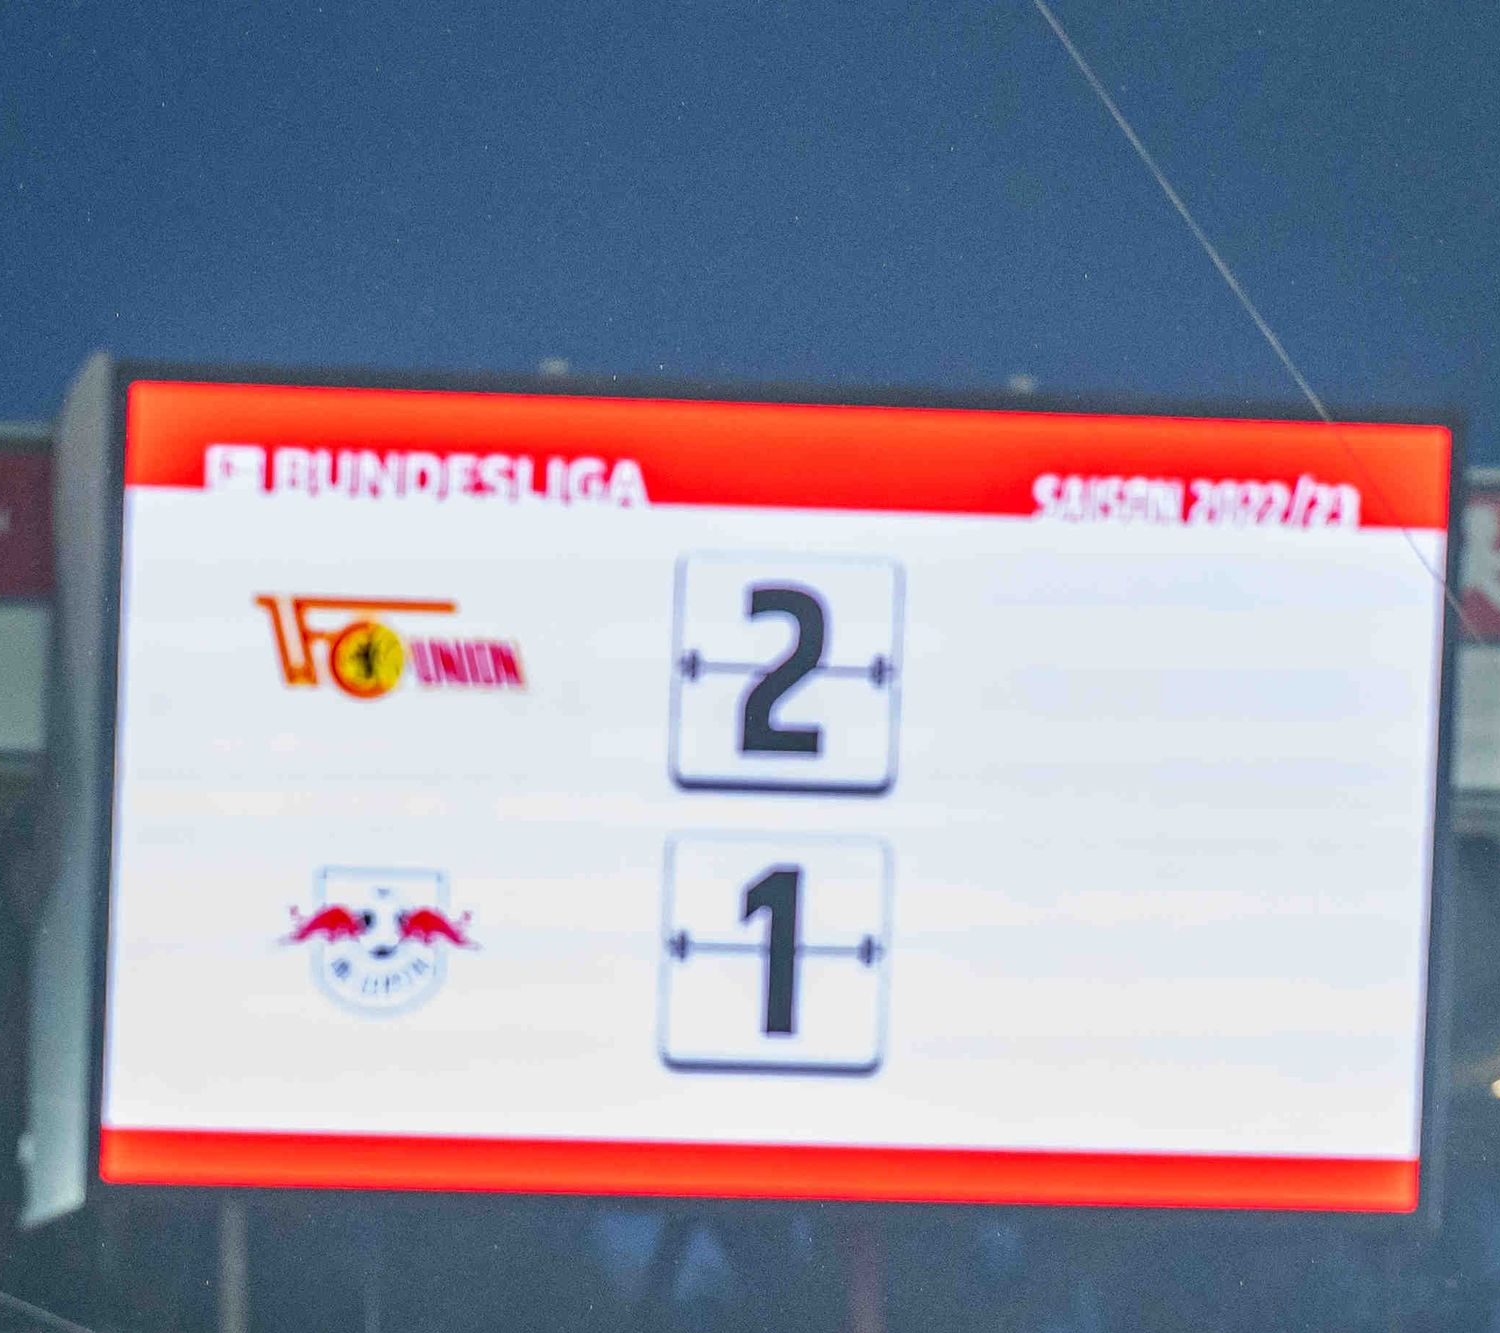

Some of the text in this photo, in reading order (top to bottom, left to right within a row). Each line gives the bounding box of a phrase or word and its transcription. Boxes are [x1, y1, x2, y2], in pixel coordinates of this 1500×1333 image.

[272, 447, 650, 507] BUNDESLIGA
[738, 589, 829, 756] 2
[740, 864, 805, 1038] 1
